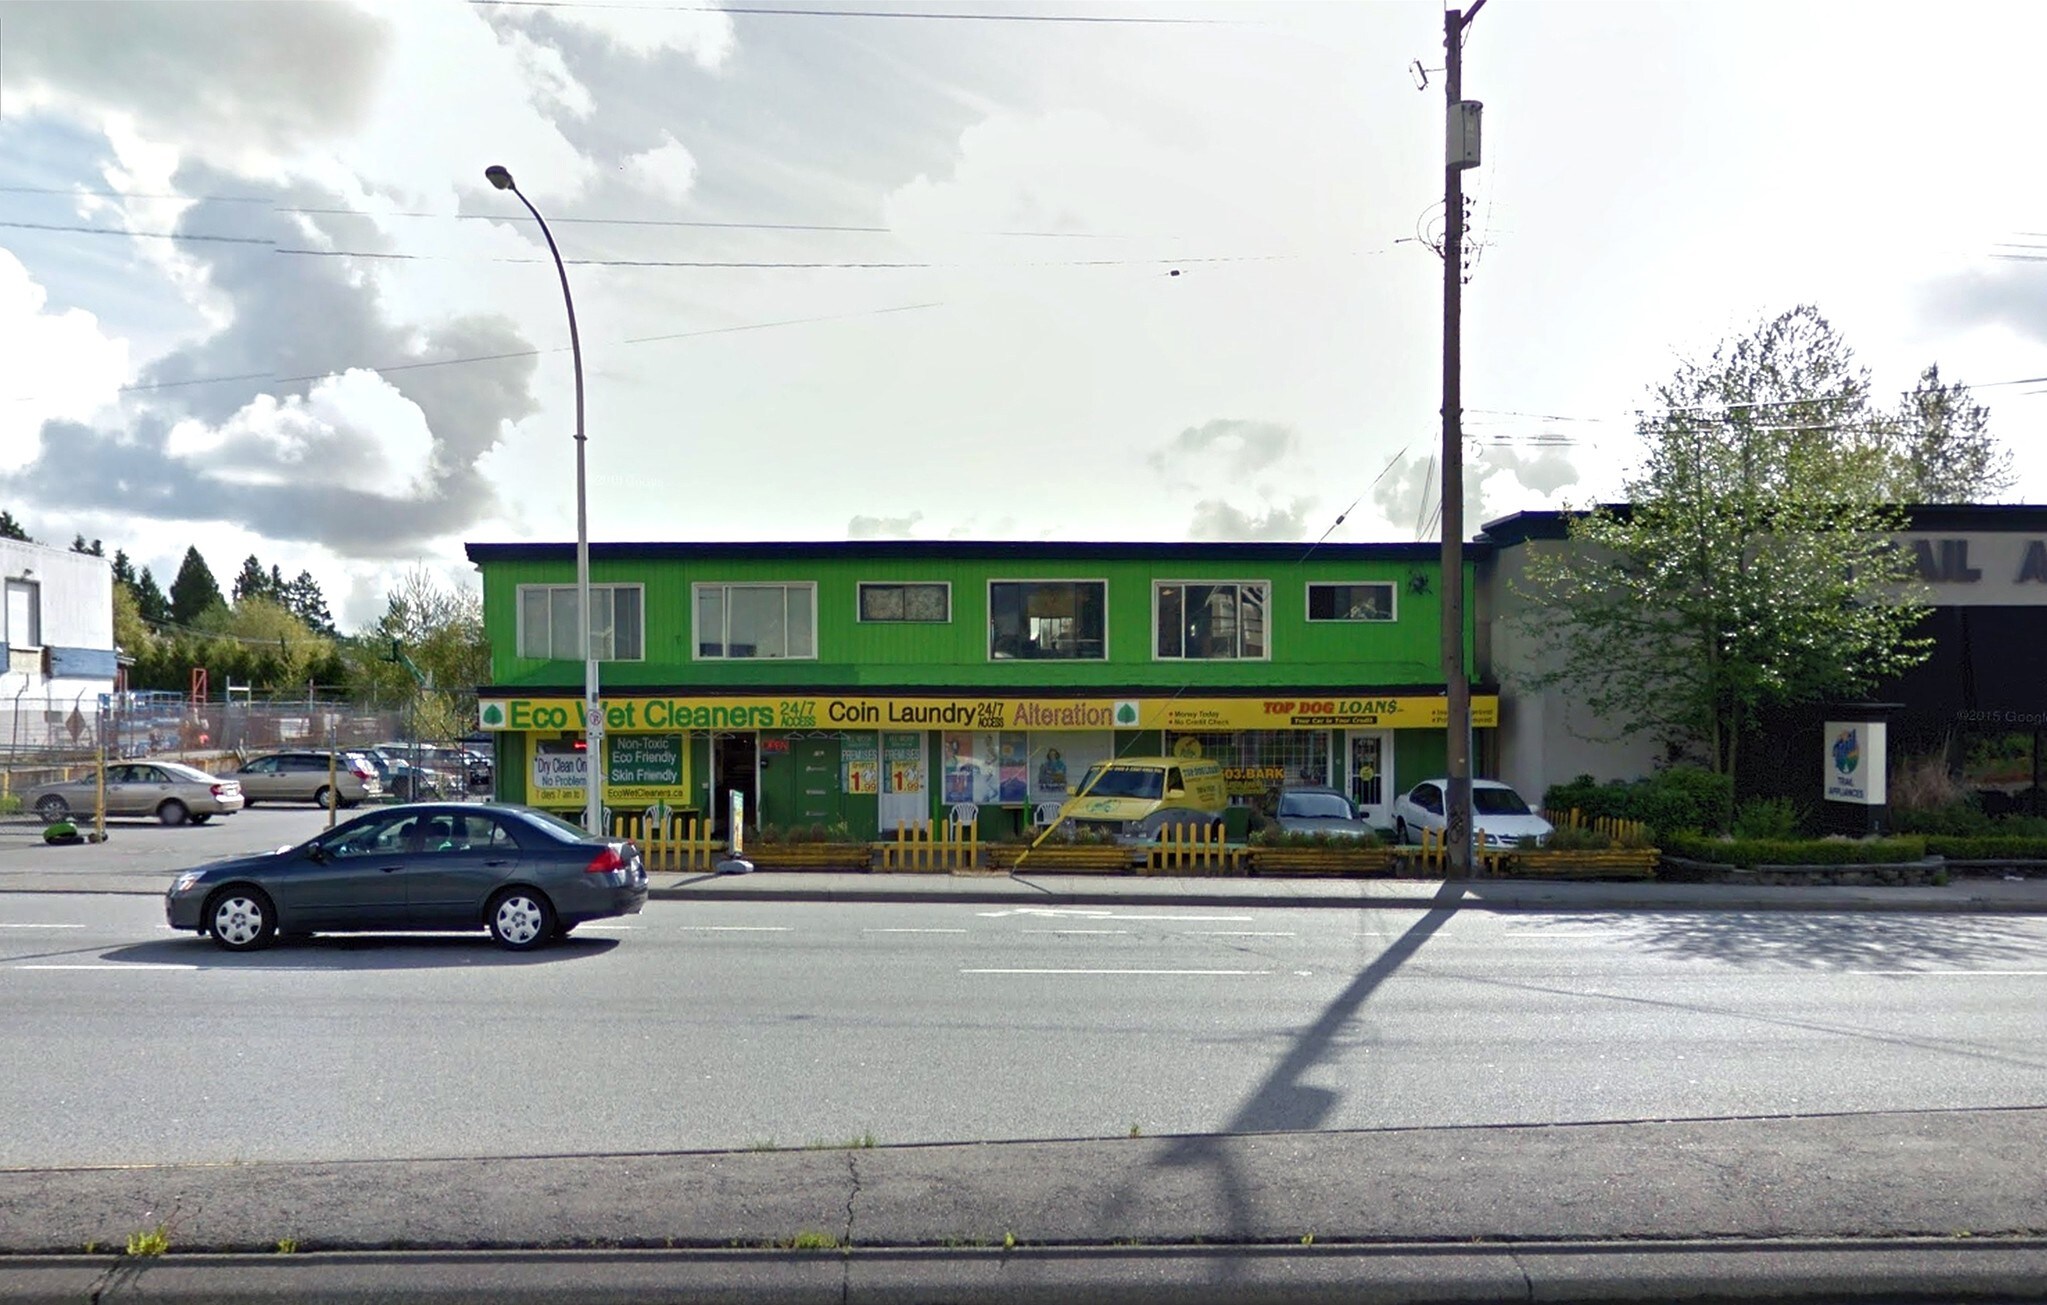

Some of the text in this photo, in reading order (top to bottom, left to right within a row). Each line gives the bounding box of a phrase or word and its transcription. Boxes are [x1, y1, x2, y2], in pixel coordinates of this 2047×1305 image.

[1893, 539, 1983, 584] AIL
[511, 701, 568, 729] Eco
[644, 700, 774, 728] Cleaners
[780, 701, 816, 716] 24/7
[828, 701, 977, 726] Coin Laundry
[977, 702, 1004, 717] 24/7
[1013, 702, 1113, 727] Alteration
[1174, 710, 1220, 719] Money Today
[1263, 701, 1296, 714] TOP
[1298, 701, 1335, 714] DOG
[780, 716, 816, 727] ACCESS
[977, 717, 1004, 728] ACCESS
[617, 737, 669, 750] Non-Toxic
[552, 757, 575, 773] Clean
[576, 757, 588, 773] On
[612, 751, 677, 765] Eco Friendly
[542, 776, 554, 786] No
[611, 769, 678, 784] Skin Friendly
[1222, 768, 1285, 780] 03.BARK
[608, 788, 684, 799] EcoWetCleaners.ca
